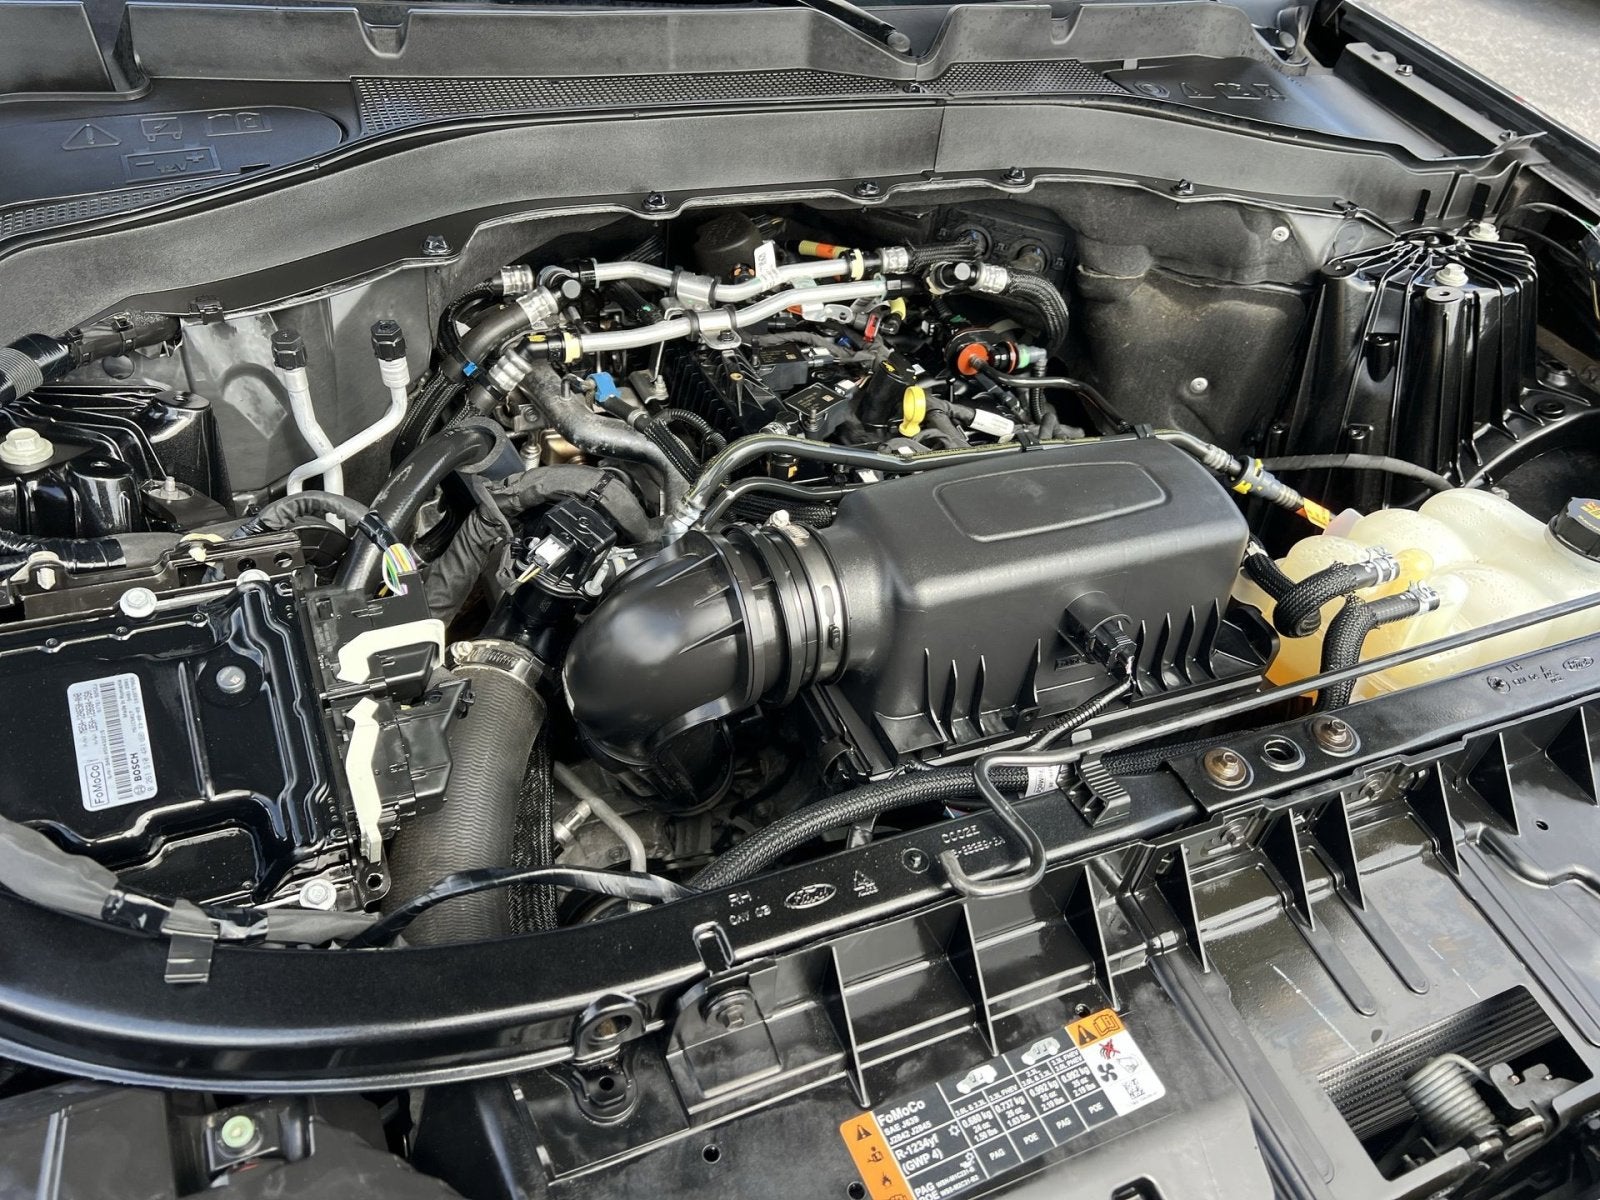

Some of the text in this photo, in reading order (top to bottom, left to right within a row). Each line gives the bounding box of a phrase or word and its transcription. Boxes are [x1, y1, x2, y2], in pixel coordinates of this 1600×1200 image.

[130, 753, 142, 781] BOSCH
[90, 765, 104, 804] FoMoCo
[729, 891, 752, 907] RH
[1061, 1064, 1090, 1083] 0.992 kg
[1029, 1080, 1059, 1097] 0.992 kg
[1073, 1083, 1096, 1097] 2.19 lbs
[995, 1096, 1026, 1113] 0.737 kg
[1041, 1097, 1065, 1111] 2.19 lbs
[1088, 1102, 1103, 1114] POE
[877, 1100, 925, 1127] FoMoCo
[962, 1110, 993, 1128] 0.680 kg
[1019, 1113, 1030, 1121] lbs
[884, 1116, 919, 1135] SAE J639
[973, 1124, 982, 1133] 24
[1056, 1118, 1071, 1129] PAG
[974, 1128, 998, 1142] 1.50 lbs
[1023, 1133, 1038, 1144] POE
[895, 1133, 939, 1162] R-1234yf
[989, 1148, 1005, 1160] PAG
[902, 1148, 943, 1176] (GWP 4)
[914, 1181, 936, 1198] PAG
